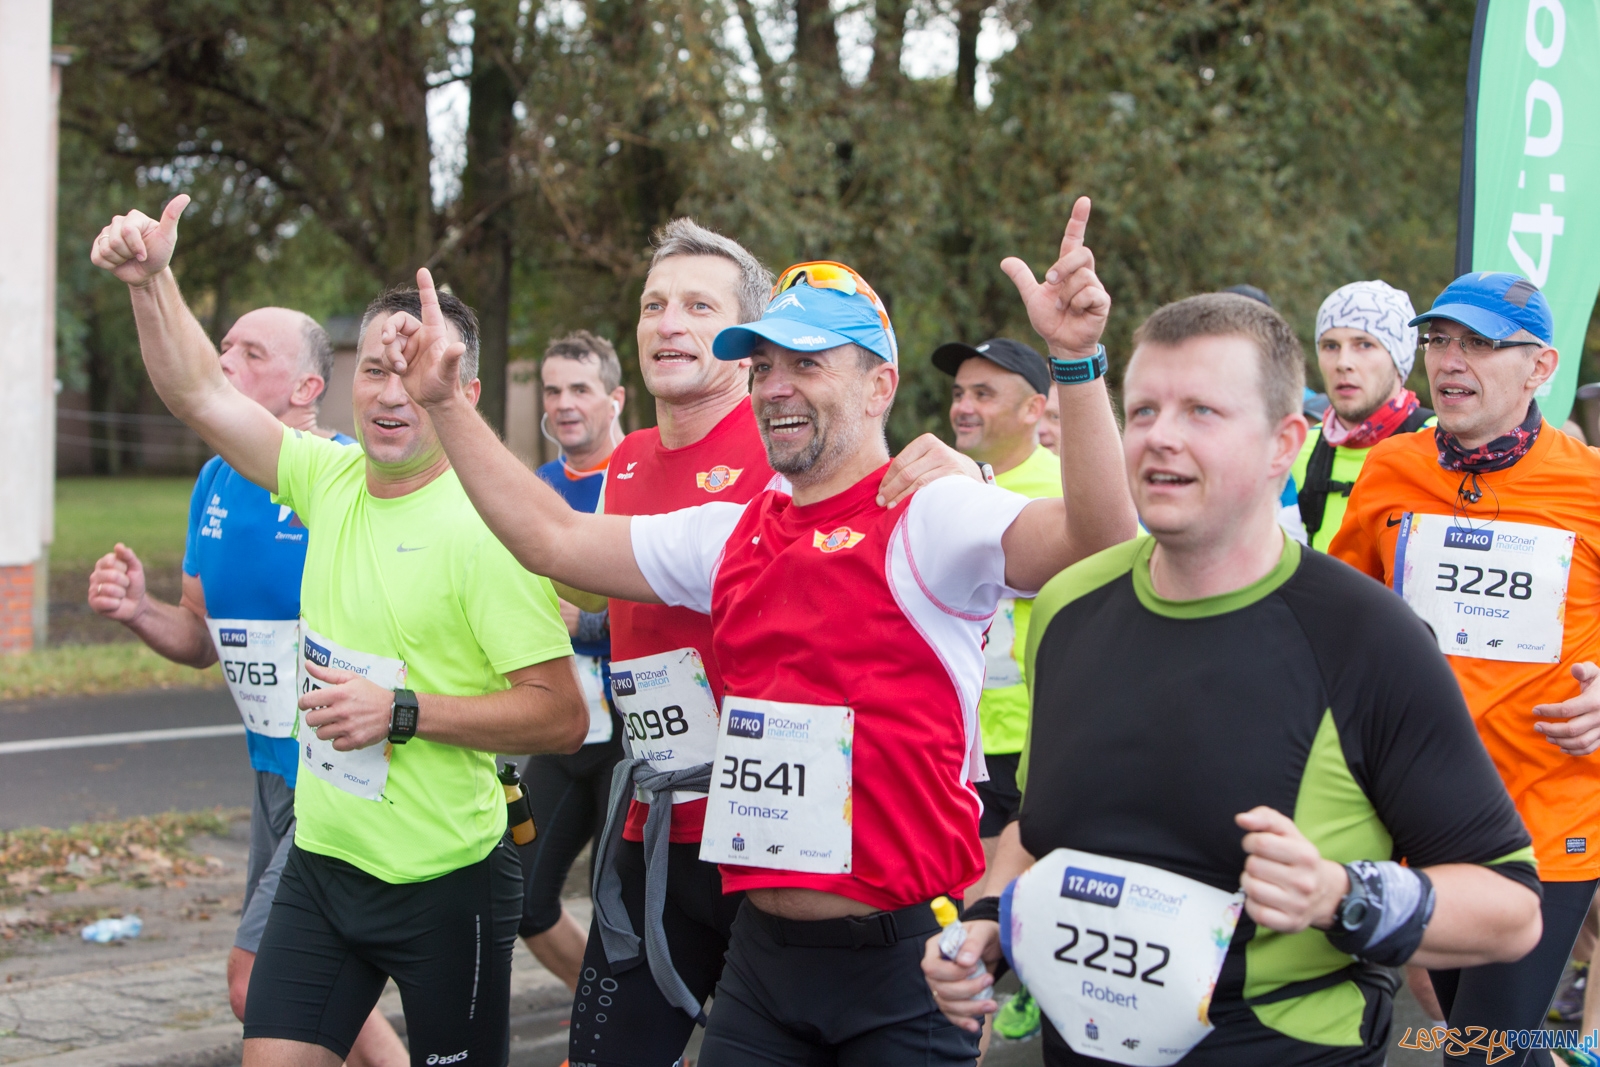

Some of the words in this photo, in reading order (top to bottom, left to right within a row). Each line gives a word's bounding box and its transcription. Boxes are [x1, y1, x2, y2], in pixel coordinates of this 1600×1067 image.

[792, 335, 827, 347] sailfish
[275, 531, 303, 541] Zermatt
[1495, 542, 1534, 553] maraton
[1435, 562, 1533, 601] 3228
[1453, 601, 1510, 619] Tomasz
[1486, 638, 1504, 648] 4F
[224, 660, 278, 686] 6763
[637, 676, 670, 690] maraton
[239, 690, 267, 703] Dariusz
[767, 728, 809, 739] maraton
[321, 761, 335, 772] 4F
[720, 755, 806, 797] 3641
[728, 800, 789, 820] Tomasz
[766, 844, 785, 855] 4F
[1126, 896, 1181, 916] maraton
[1054, 922, 1170, 987] 2232
[1081, 980, 1138, 1010] Robert
[1121, 1038, 1141, 1051] 4F
[438, 1050, 468, 1065] asics
